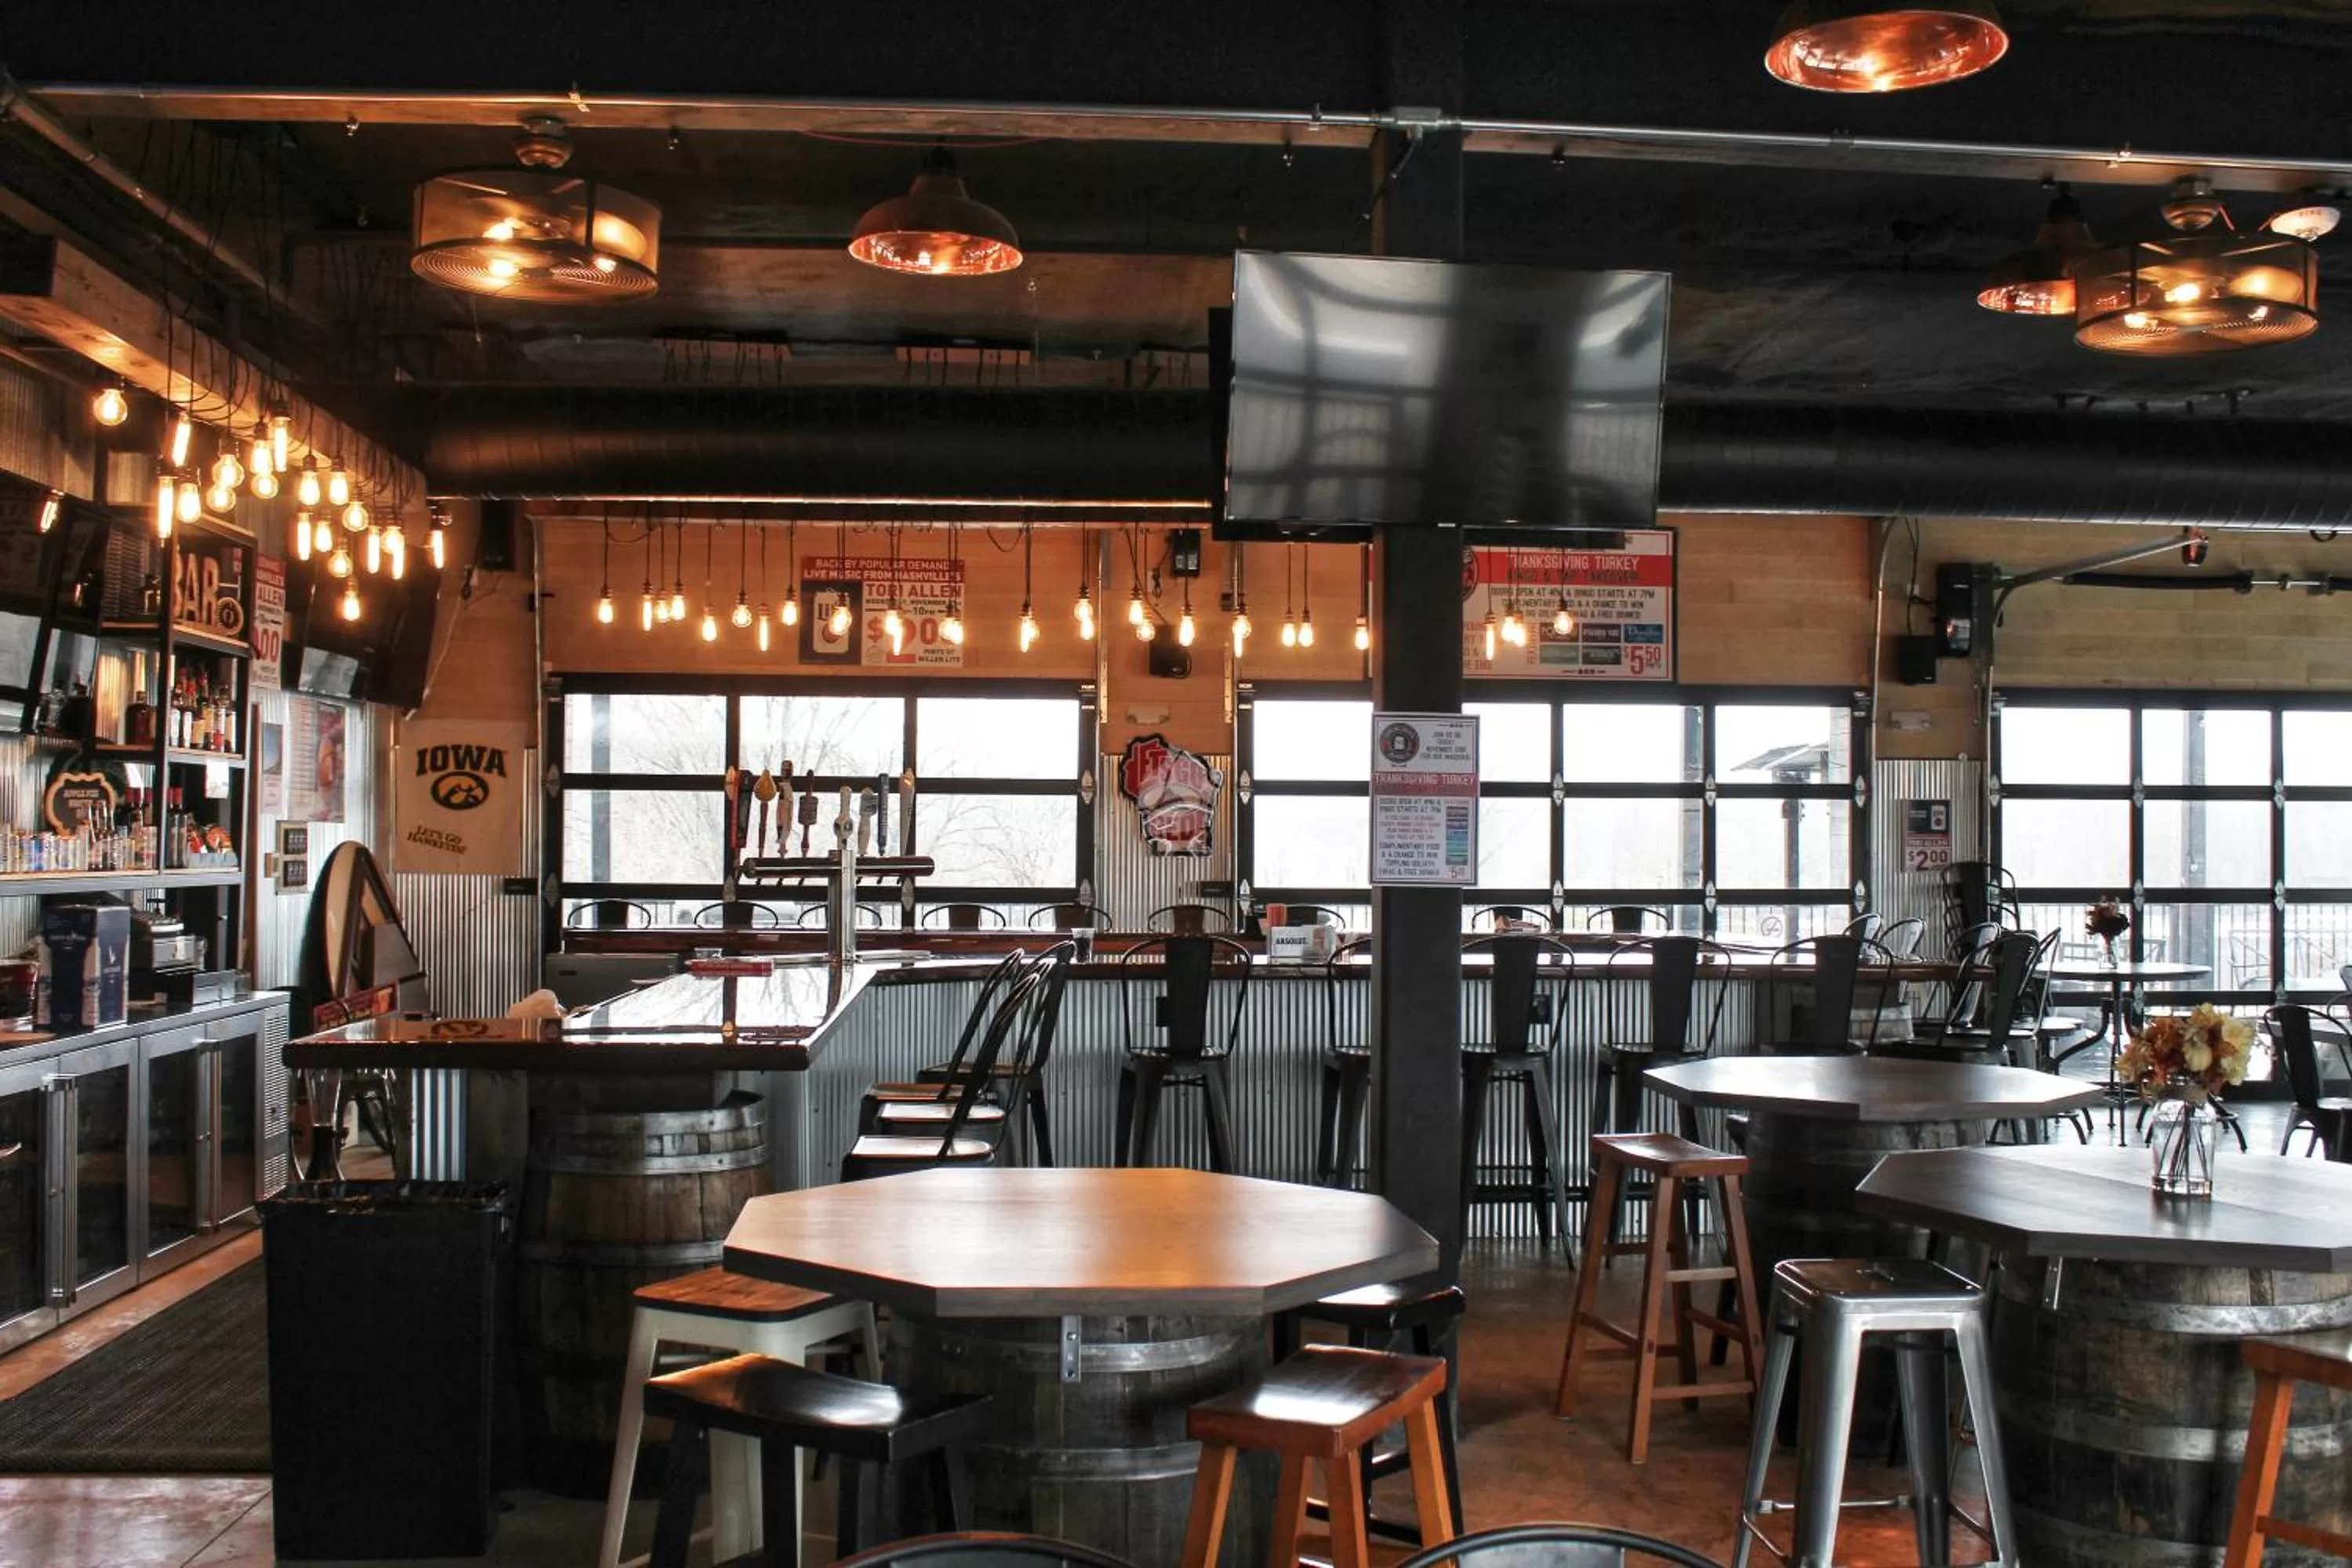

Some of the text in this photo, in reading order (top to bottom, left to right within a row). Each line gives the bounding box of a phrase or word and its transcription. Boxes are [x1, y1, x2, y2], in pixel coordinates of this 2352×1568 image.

[845, 559, 857, 568] BY
[861, 559, 905, 569] POPULAR
[1505, 554, 1639, 570] THANKSGIVING TURKEY
[804, 568, 827, 579] LIVE
[829, 569, 862, 579] MUSIC
[863, 569, 892, 580] FROM
[171, 546, 220, 627] BAR
[866, 583, 962, 598] TORI ALLEN
[1537, 587, 1548, 597] AT
[1628, 589, 1637, 598] AT
[416, 742, 510, 778] IOWA
[1442, 774, 1475, 786] TURKEY
[1907, 849, 1948, 872] $200
